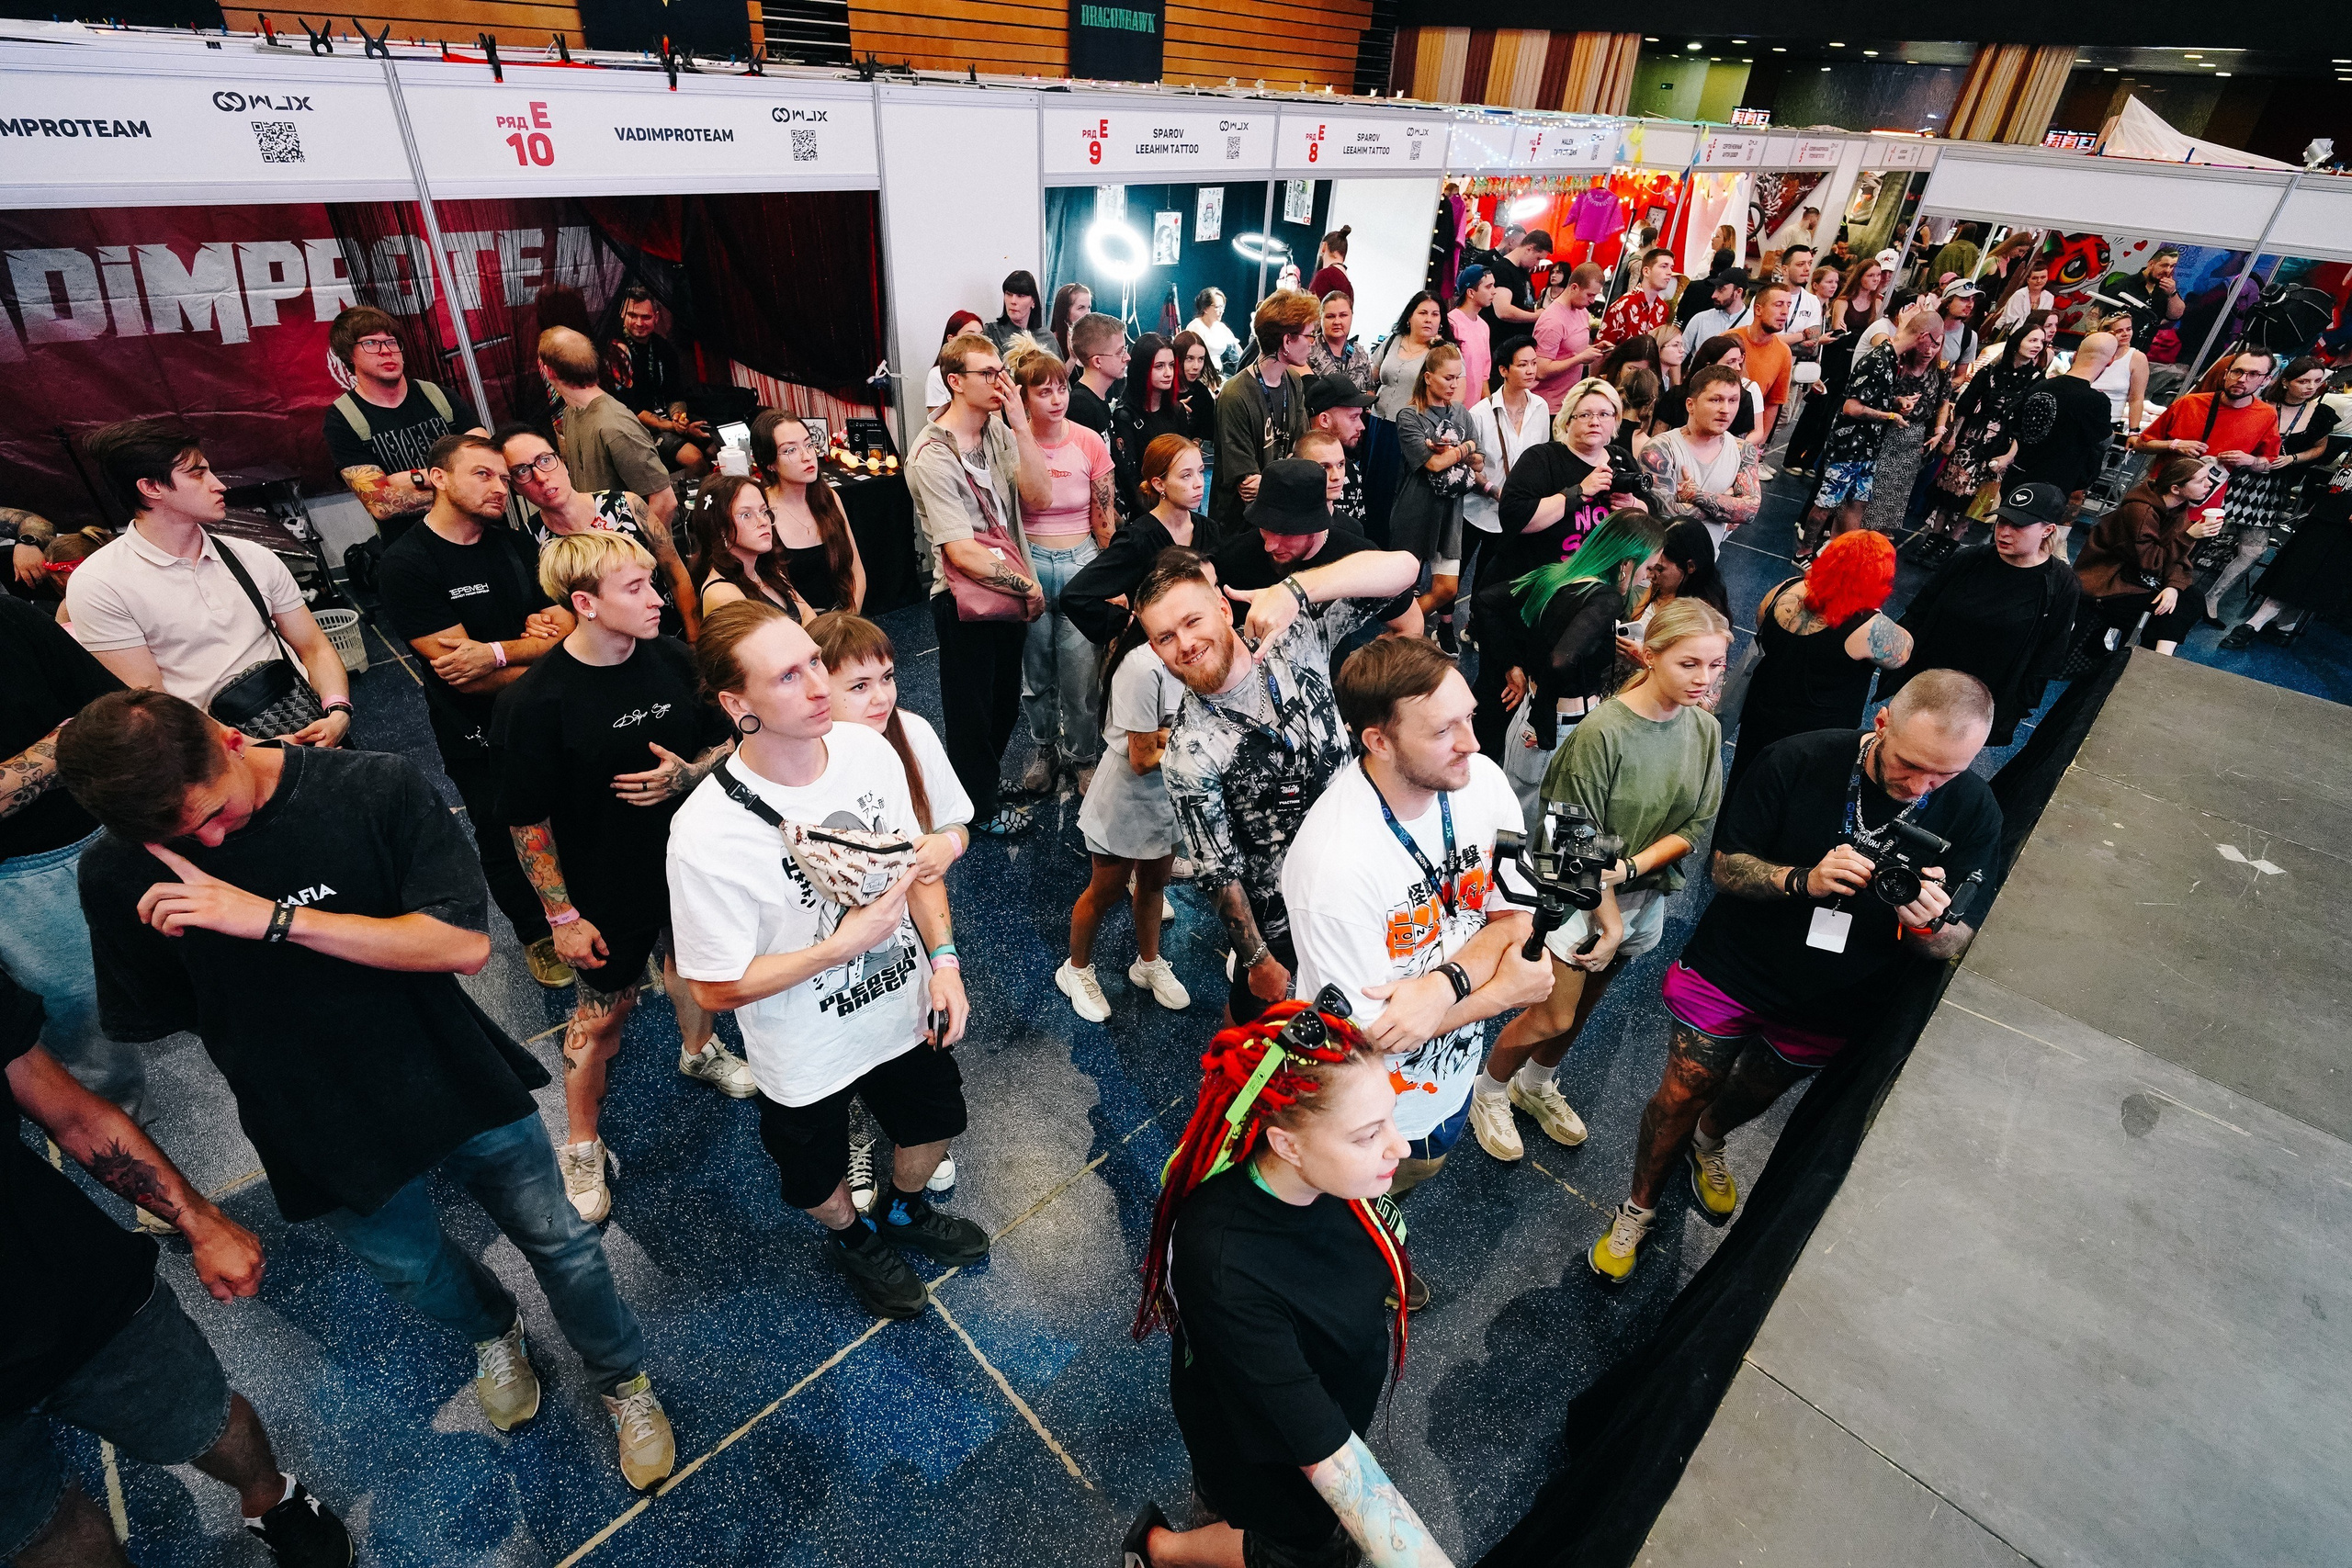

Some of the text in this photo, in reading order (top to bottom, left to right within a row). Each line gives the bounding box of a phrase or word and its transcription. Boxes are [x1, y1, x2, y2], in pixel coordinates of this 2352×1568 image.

[1081, 5, 1156, 33] DRAGONHAWK
[496, 116, 529, 131] РЯД
[615, 127, 734, 142] VADIMPROTEAM
[1082, 130, 1097, 140] РЯД
[1153, 129, 1184, 139] SPAROV
[1357, 132, 1381, 142] SPAROV
[506, 132, 555, 167] 10
[1089, 141, 1102, 165] 9
[1136, 143, 1200, 154] LEEAHIM TATTOO
[1308, 142, 1318, 164] 8
[1342, 146, 1391, 155] LEEAHIM TATTOO
[1531, 147, 1537, 162] 7
[1414, 850, 1430, 870] NOIR
[277, 883, 337, 908] AFIA
